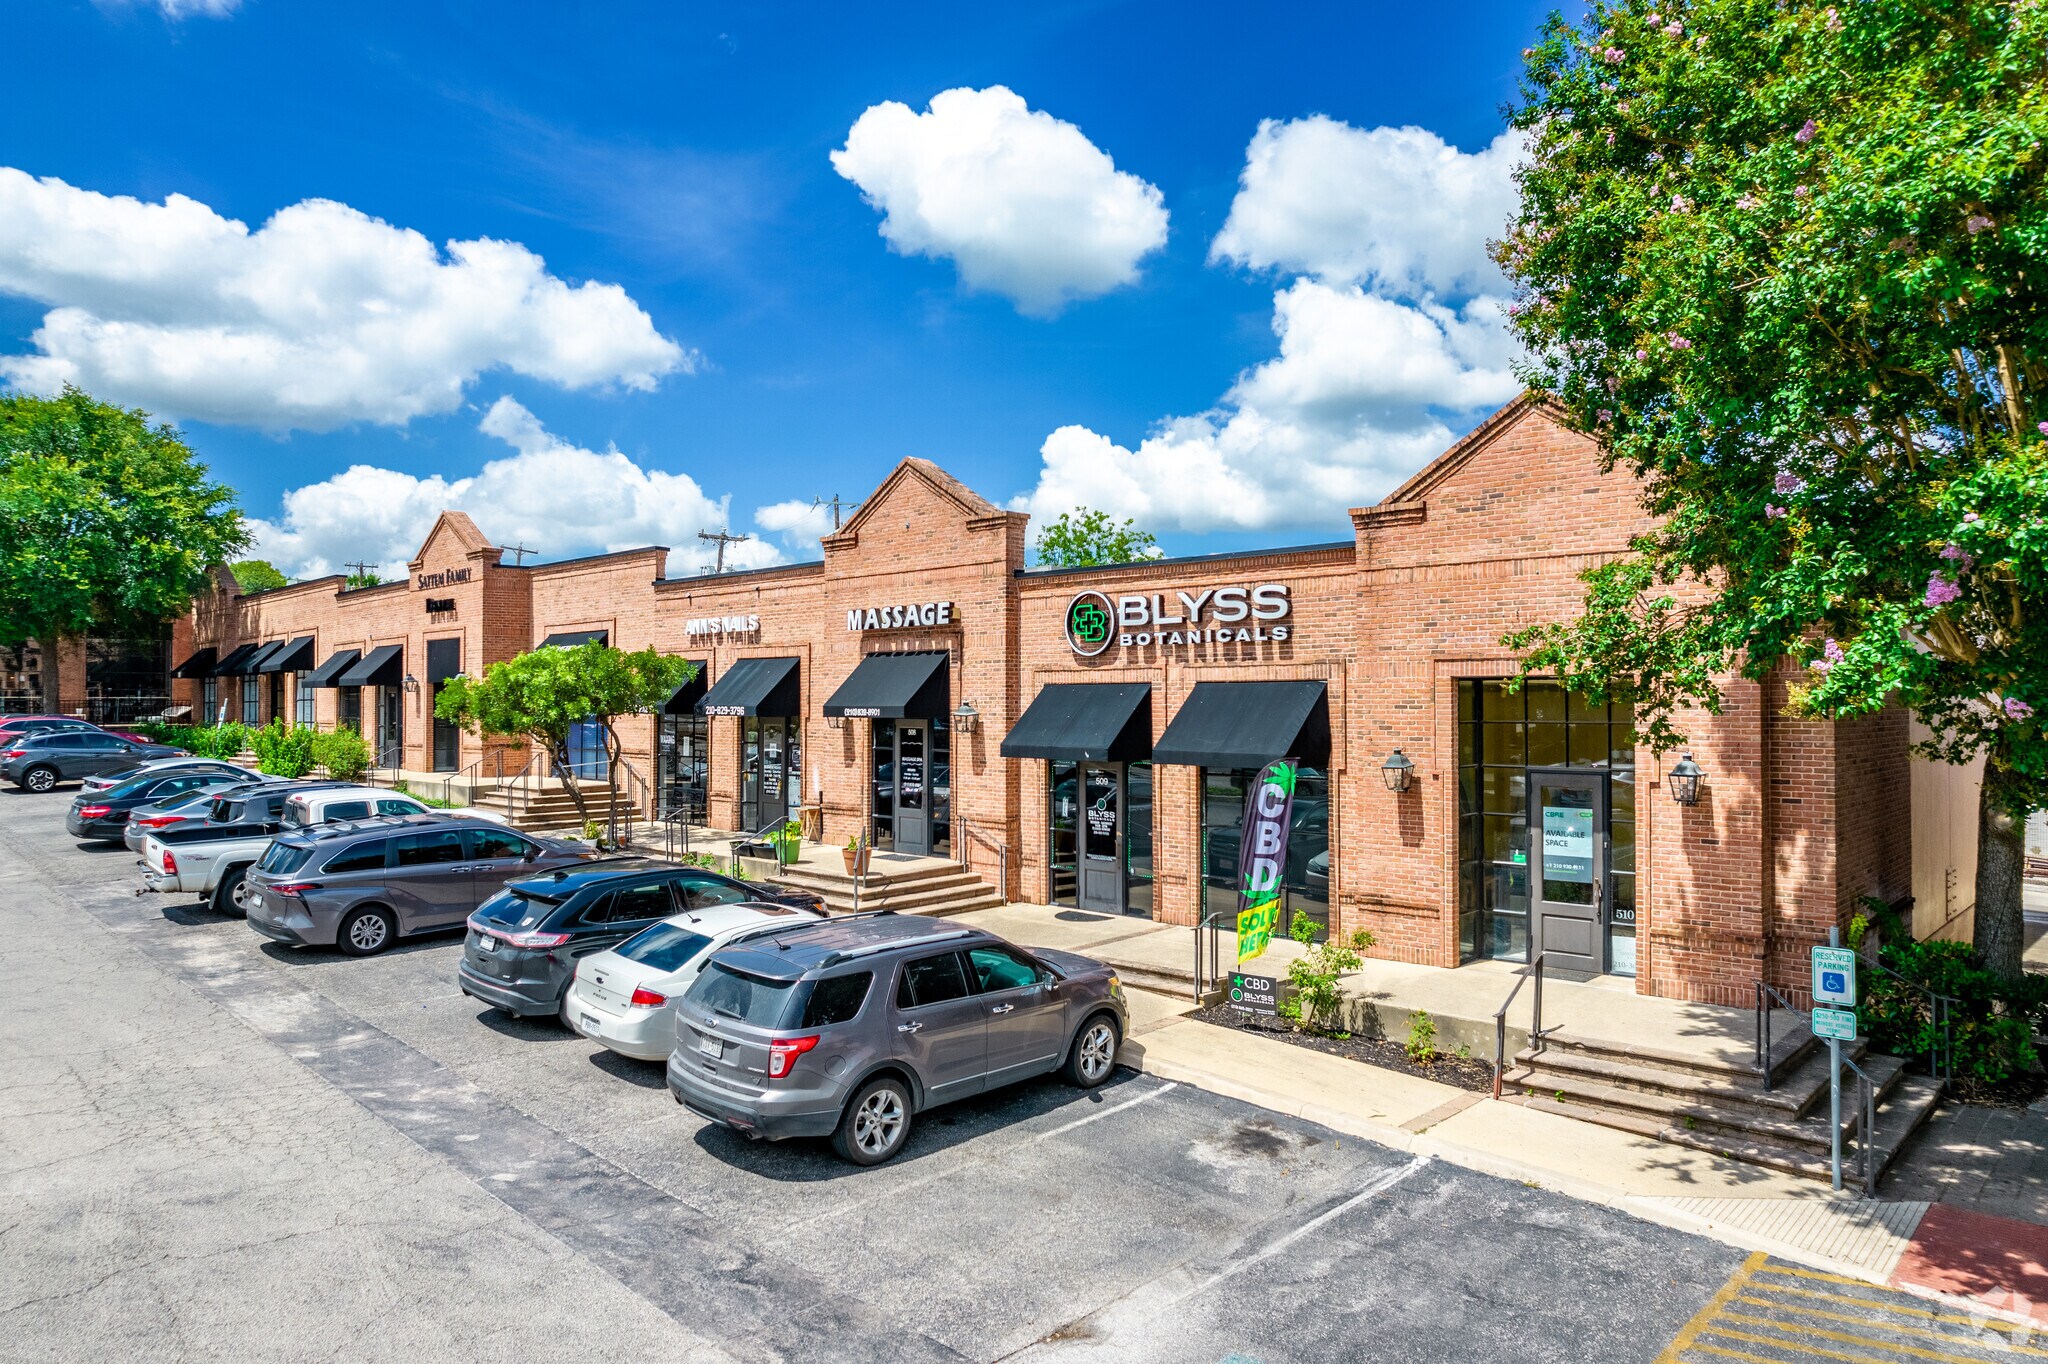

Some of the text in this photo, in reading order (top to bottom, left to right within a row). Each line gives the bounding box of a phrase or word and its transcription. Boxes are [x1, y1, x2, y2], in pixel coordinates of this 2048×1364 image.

[1119, 584, 1289, 626] BLYSS
[847, 602, 951, 630] MASSAGE
[722, 614, 759, 632] NAILS
[1120, 626, 1288, 647] BOTANICALS
[1095, 777, 1109, 786] 509
[1088, 810, 1116, 818] BLYSS
[1251, 783, 1286, 892] CBD
[1545, 830, 1585, 838] AVAILABLE
[1545, 839, 1568, 847] SPACE
[1616, 909, 1635, 920] 510
[1815, 952, 1852, 963] RESERVED
[1818, 962, 1849, 972] PARKING
[1244, 977, 1270, 991] CBD
[1244, 992, 1274, 1002] BLYSS
